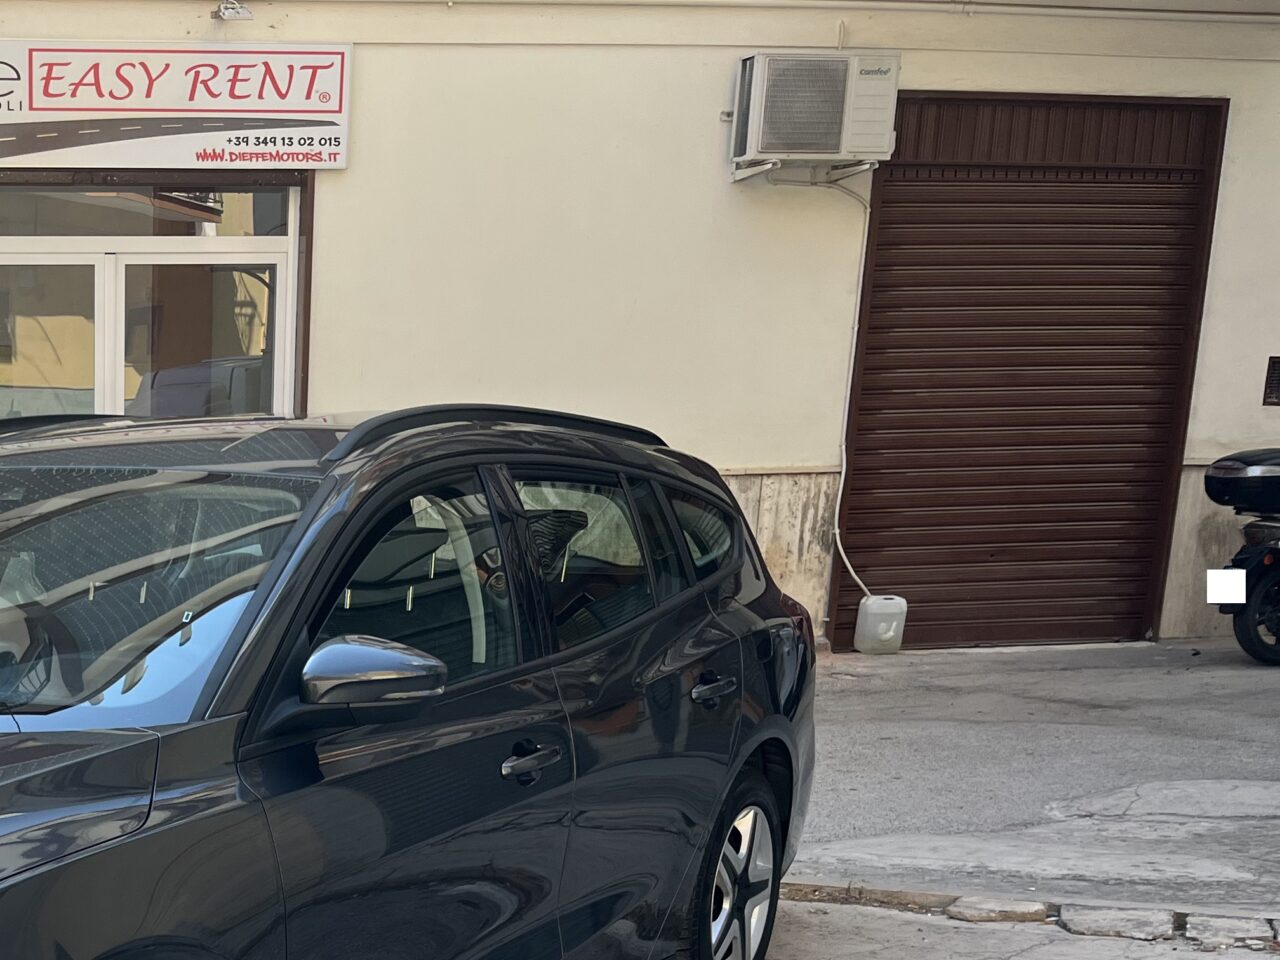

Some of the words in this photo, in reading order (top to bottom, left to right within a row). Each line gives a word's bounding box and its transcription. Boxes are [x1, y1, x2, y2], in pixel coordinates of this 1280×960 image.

[39, 61, 170, 100] EASY
[226, 137, 249, 147] +39
[254, 137, 277, 147] 349
[281, 137, 294, 147] 13
[298, 137, 314, 147] 02
[318, 137, 341, 147] 015
